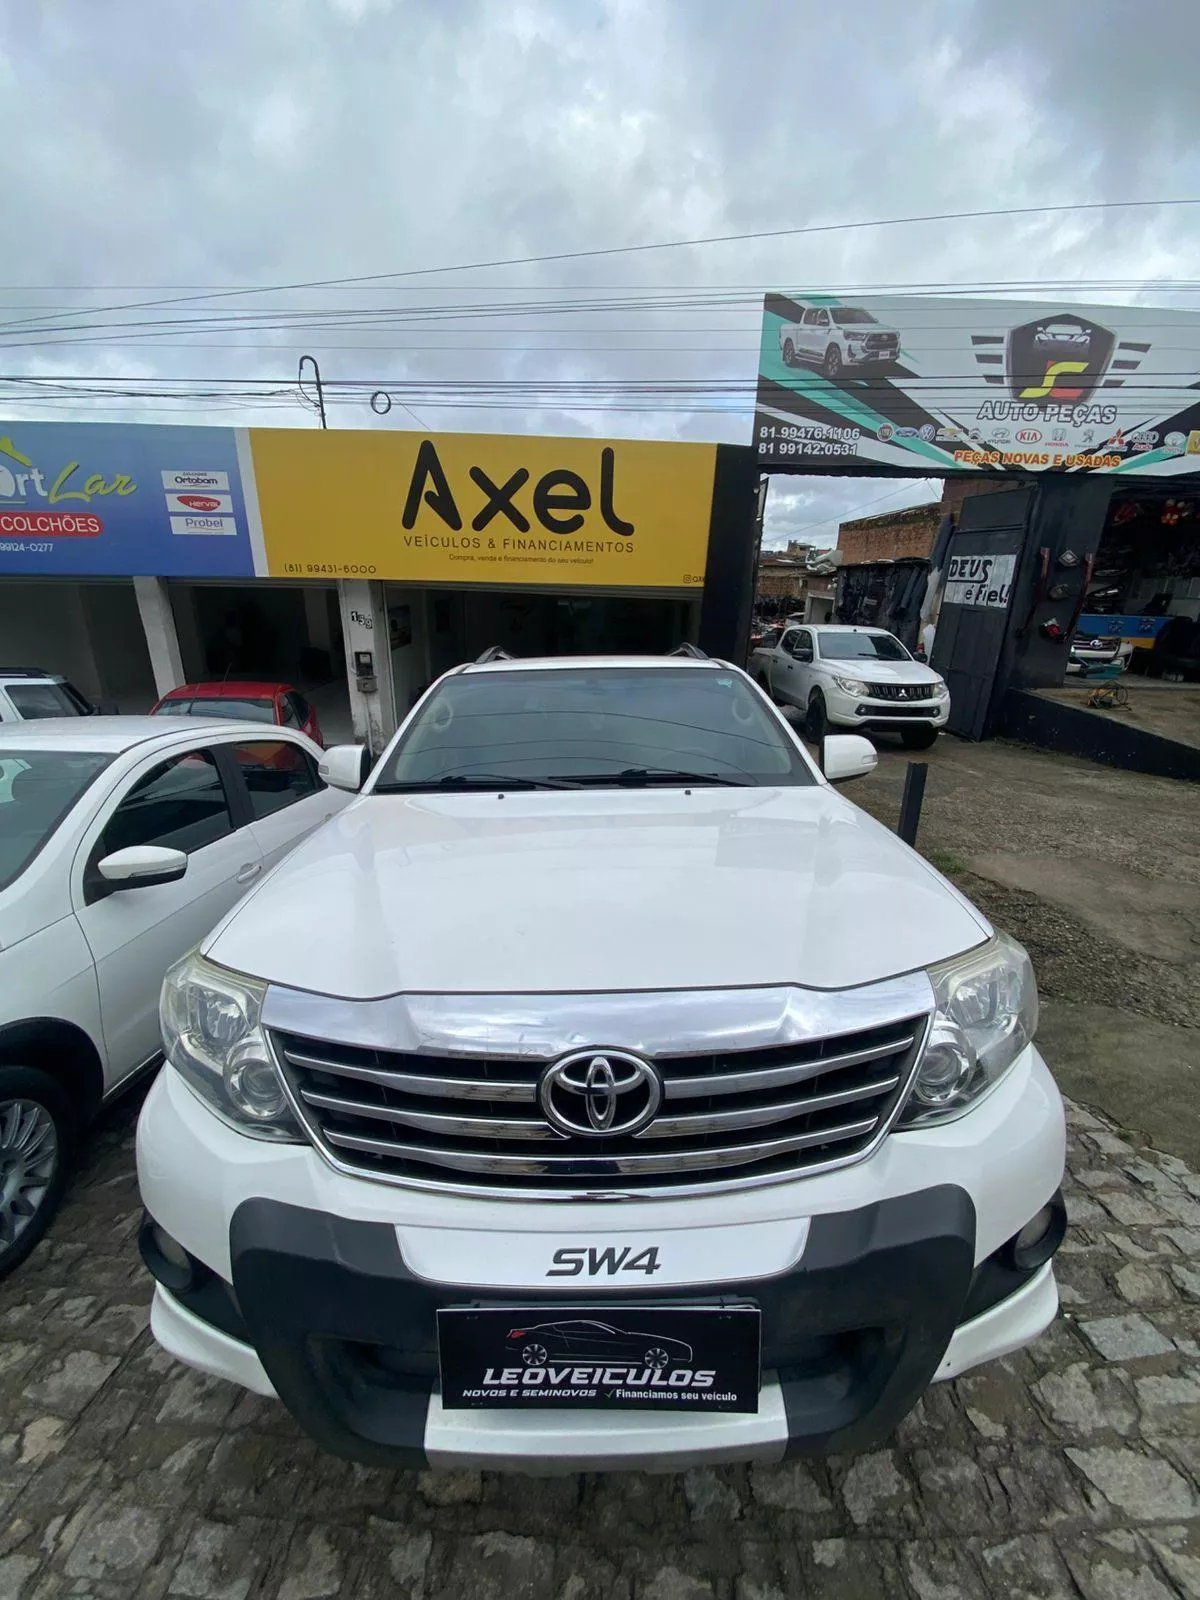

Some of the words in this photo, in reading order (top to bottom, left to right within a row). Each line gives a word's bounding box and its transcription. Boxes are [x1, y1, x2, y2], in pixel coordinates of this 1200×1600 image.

[977, 401, 1040, 421] AUTO
[1043, 405, 1118, 427] PEÇAS
[760, 426, 776, 438] 81
[780, 426, 861, 439] 99476.1106
[758, 442, 774, 454] 81
[779, 442, 858, 455] 99142.0531
[954, 450, 999, 465] PEÇAS
[1003, 452, 1048, 465] NOVAS
[1053, 454, 1061, 465] E
[1065, 455, 1121, 467] USADAS
[48, 461, 137, 504] Lar
[402, 440, 634, 536] Axel
[1, 514, 100, 533] COLCHÕES
[185, 518, 224, 527] Probel
[487, 538, 496, 549] &
[503, 538, 634, 553] FINANCIAMENTOS
[307, 564, 376, 574] 99431-6000
[949, 559, 993, 584] DEUS
[350, 610, 373, 630] 159
[545, 1246, 661, 1277] SW4
[482, 1367, 716, 1388] LEOVEICULOS
[462, 1389, 507, 1397] NOVOS
[509, 1389, 519, 1397] E
[521, 1389, 597, 1397] SEMINOVOS
[615, 1389, 678, 1400] Financiamos
[681, 1391, 699, 1400] seu
